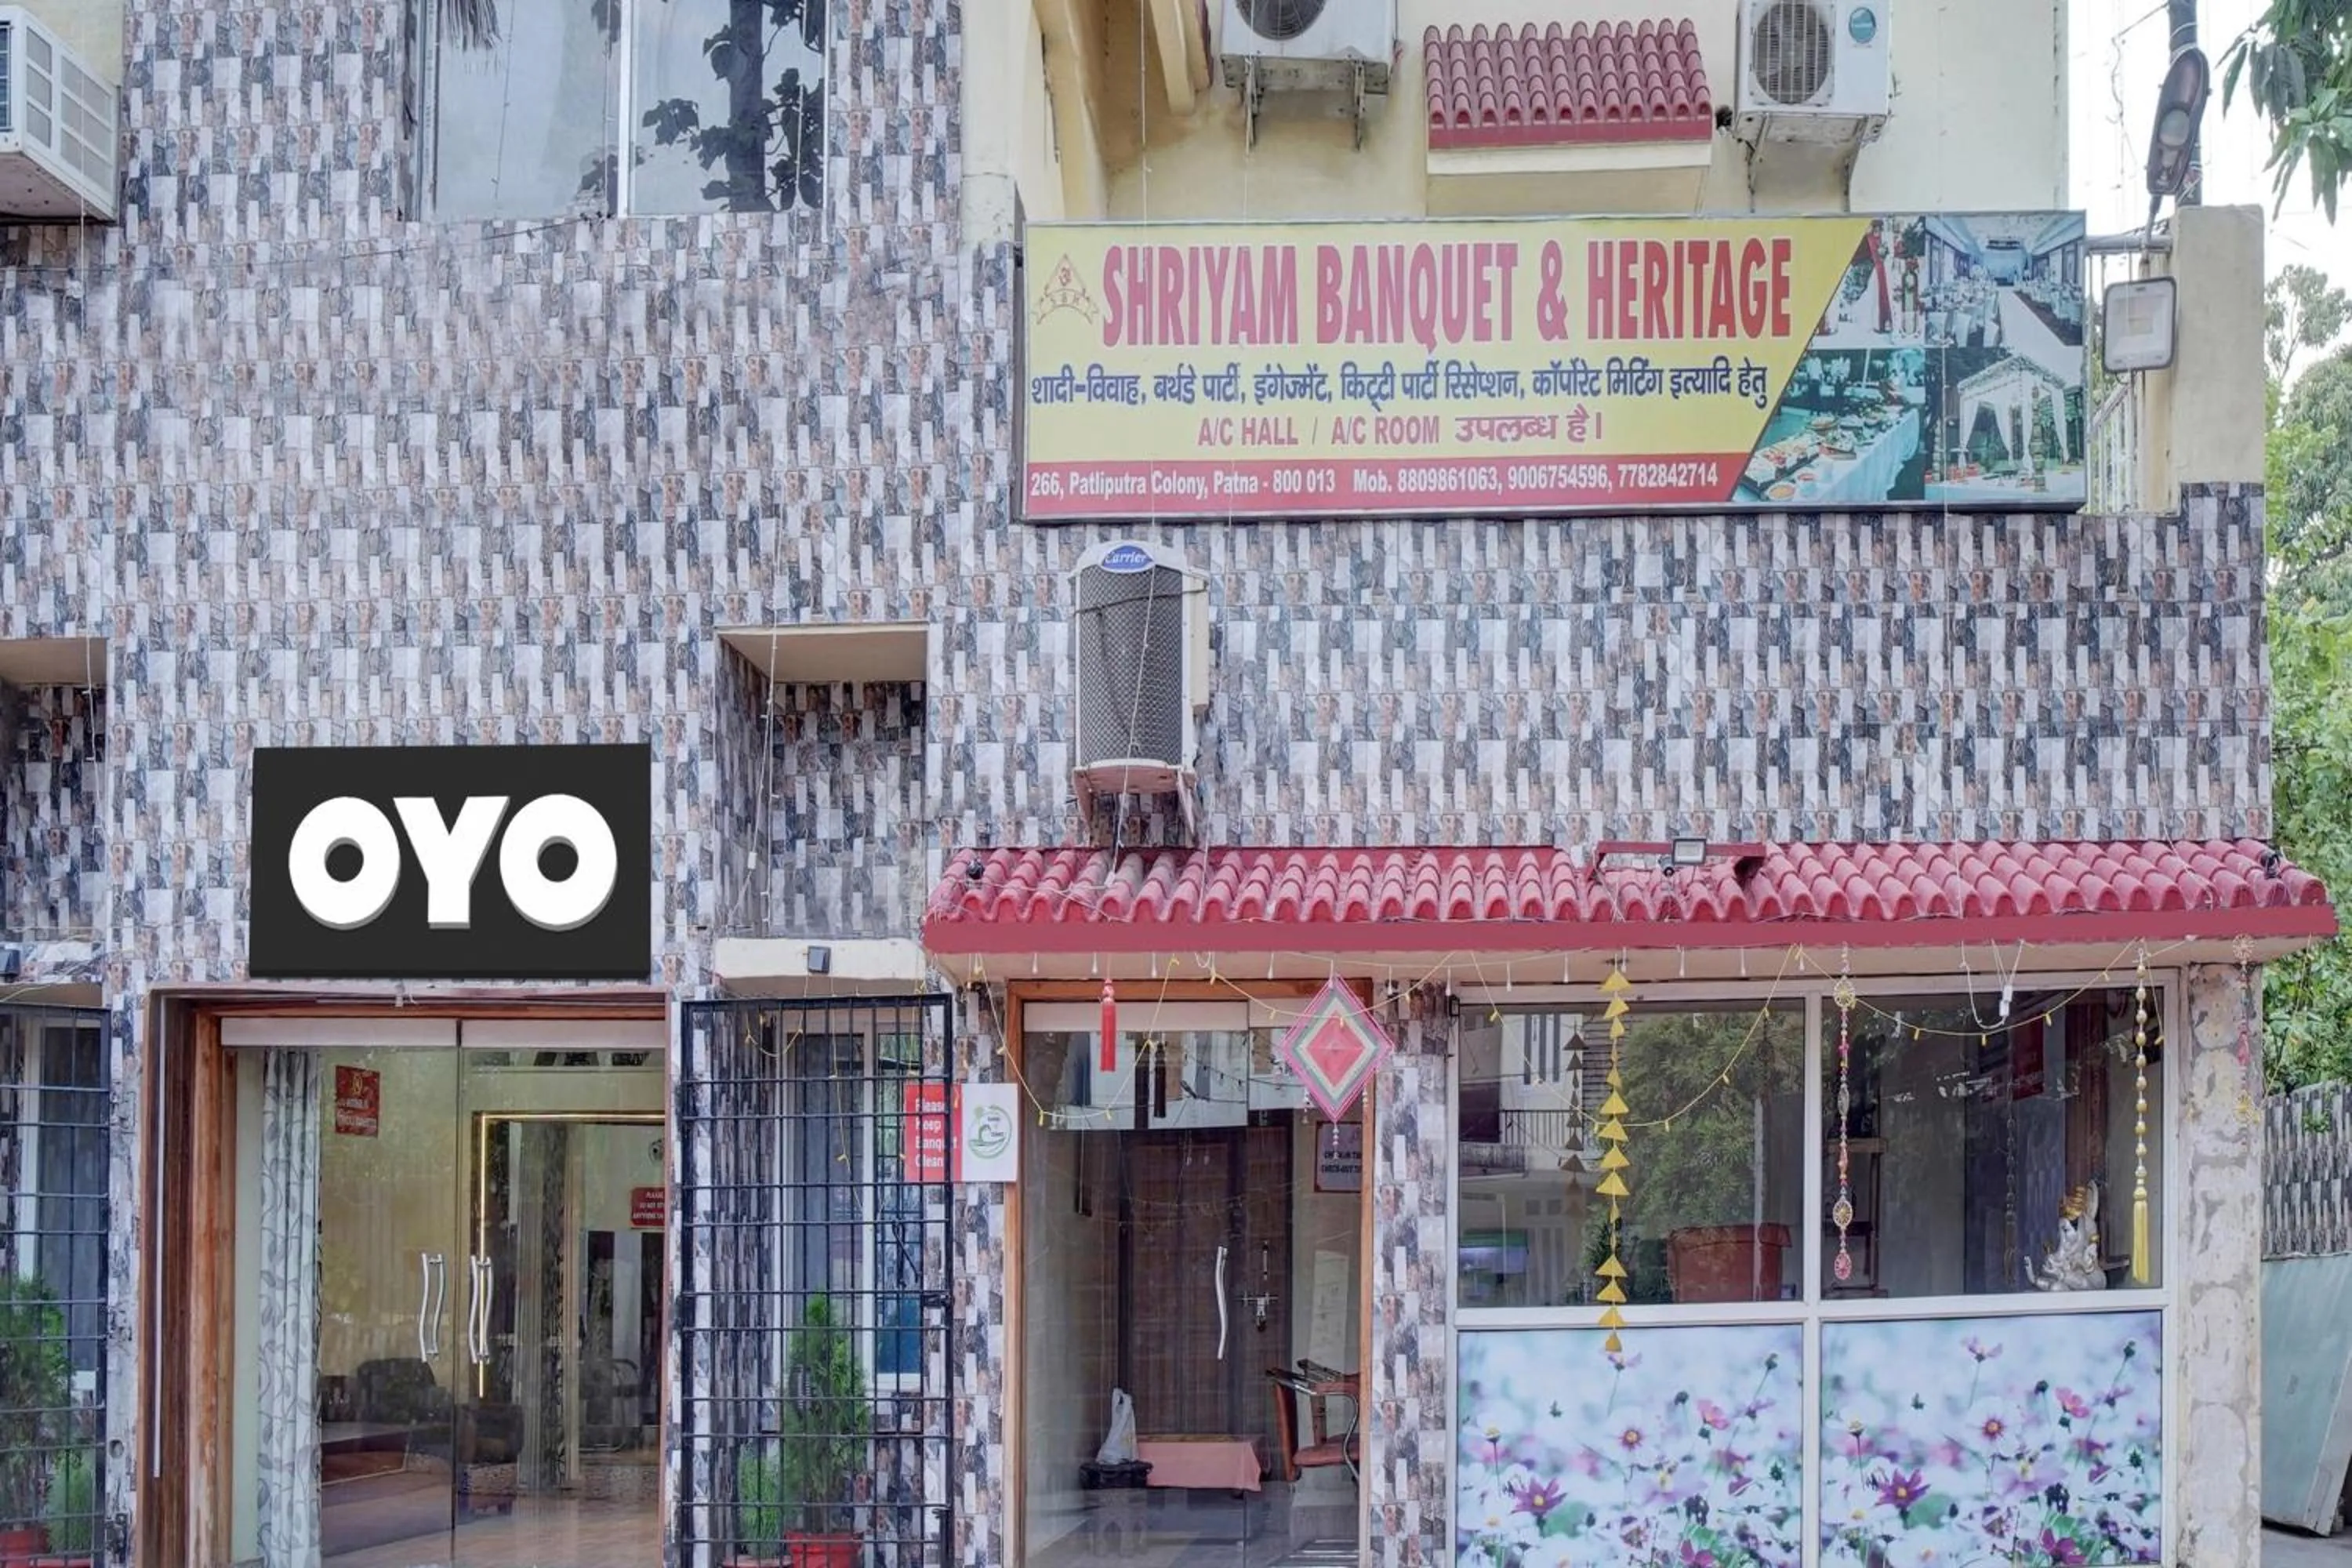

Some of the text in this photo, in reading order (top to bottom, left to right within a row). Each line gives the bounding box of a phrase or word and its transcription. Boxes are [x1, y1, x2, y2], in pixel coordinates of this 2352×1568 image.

[1103, 238, 1791, 354] SHRIYAM BANQUET & HERITAGE
[1670, 355, 1732, 399] इत्यादि
[1737, 357, 1768, 409] हेतु
[1198, 416, 1233, 446] A/C
[1241, 416, 1298, 446] HALL
[1331, 415, 1367, 445] A/C
[1374, 415, 1440, 445] ROOM
[1030, 473, 1065, 499] 266,
[1069, 471, 1146, 500] Patliputra
[1151, 470, 1208, 500] Colony,
[1213, 470, 1258, 495] Patna
[1273, 469, 1301, 493] 800
[1306, 469, 1335, 493] 013
[1353, 468, 1392, 494] Mob.
[1398, 469, 1502, 495] 8809861063,
[1508, 466, 1613, 493] 9006754596,
[1618, 463, 1718, 488] 7782842714
[1105, 550, 1146, 564] Carrier
[289, 793, 618, 931] OYO
[915, 1135, 958, 1152] Banqt
